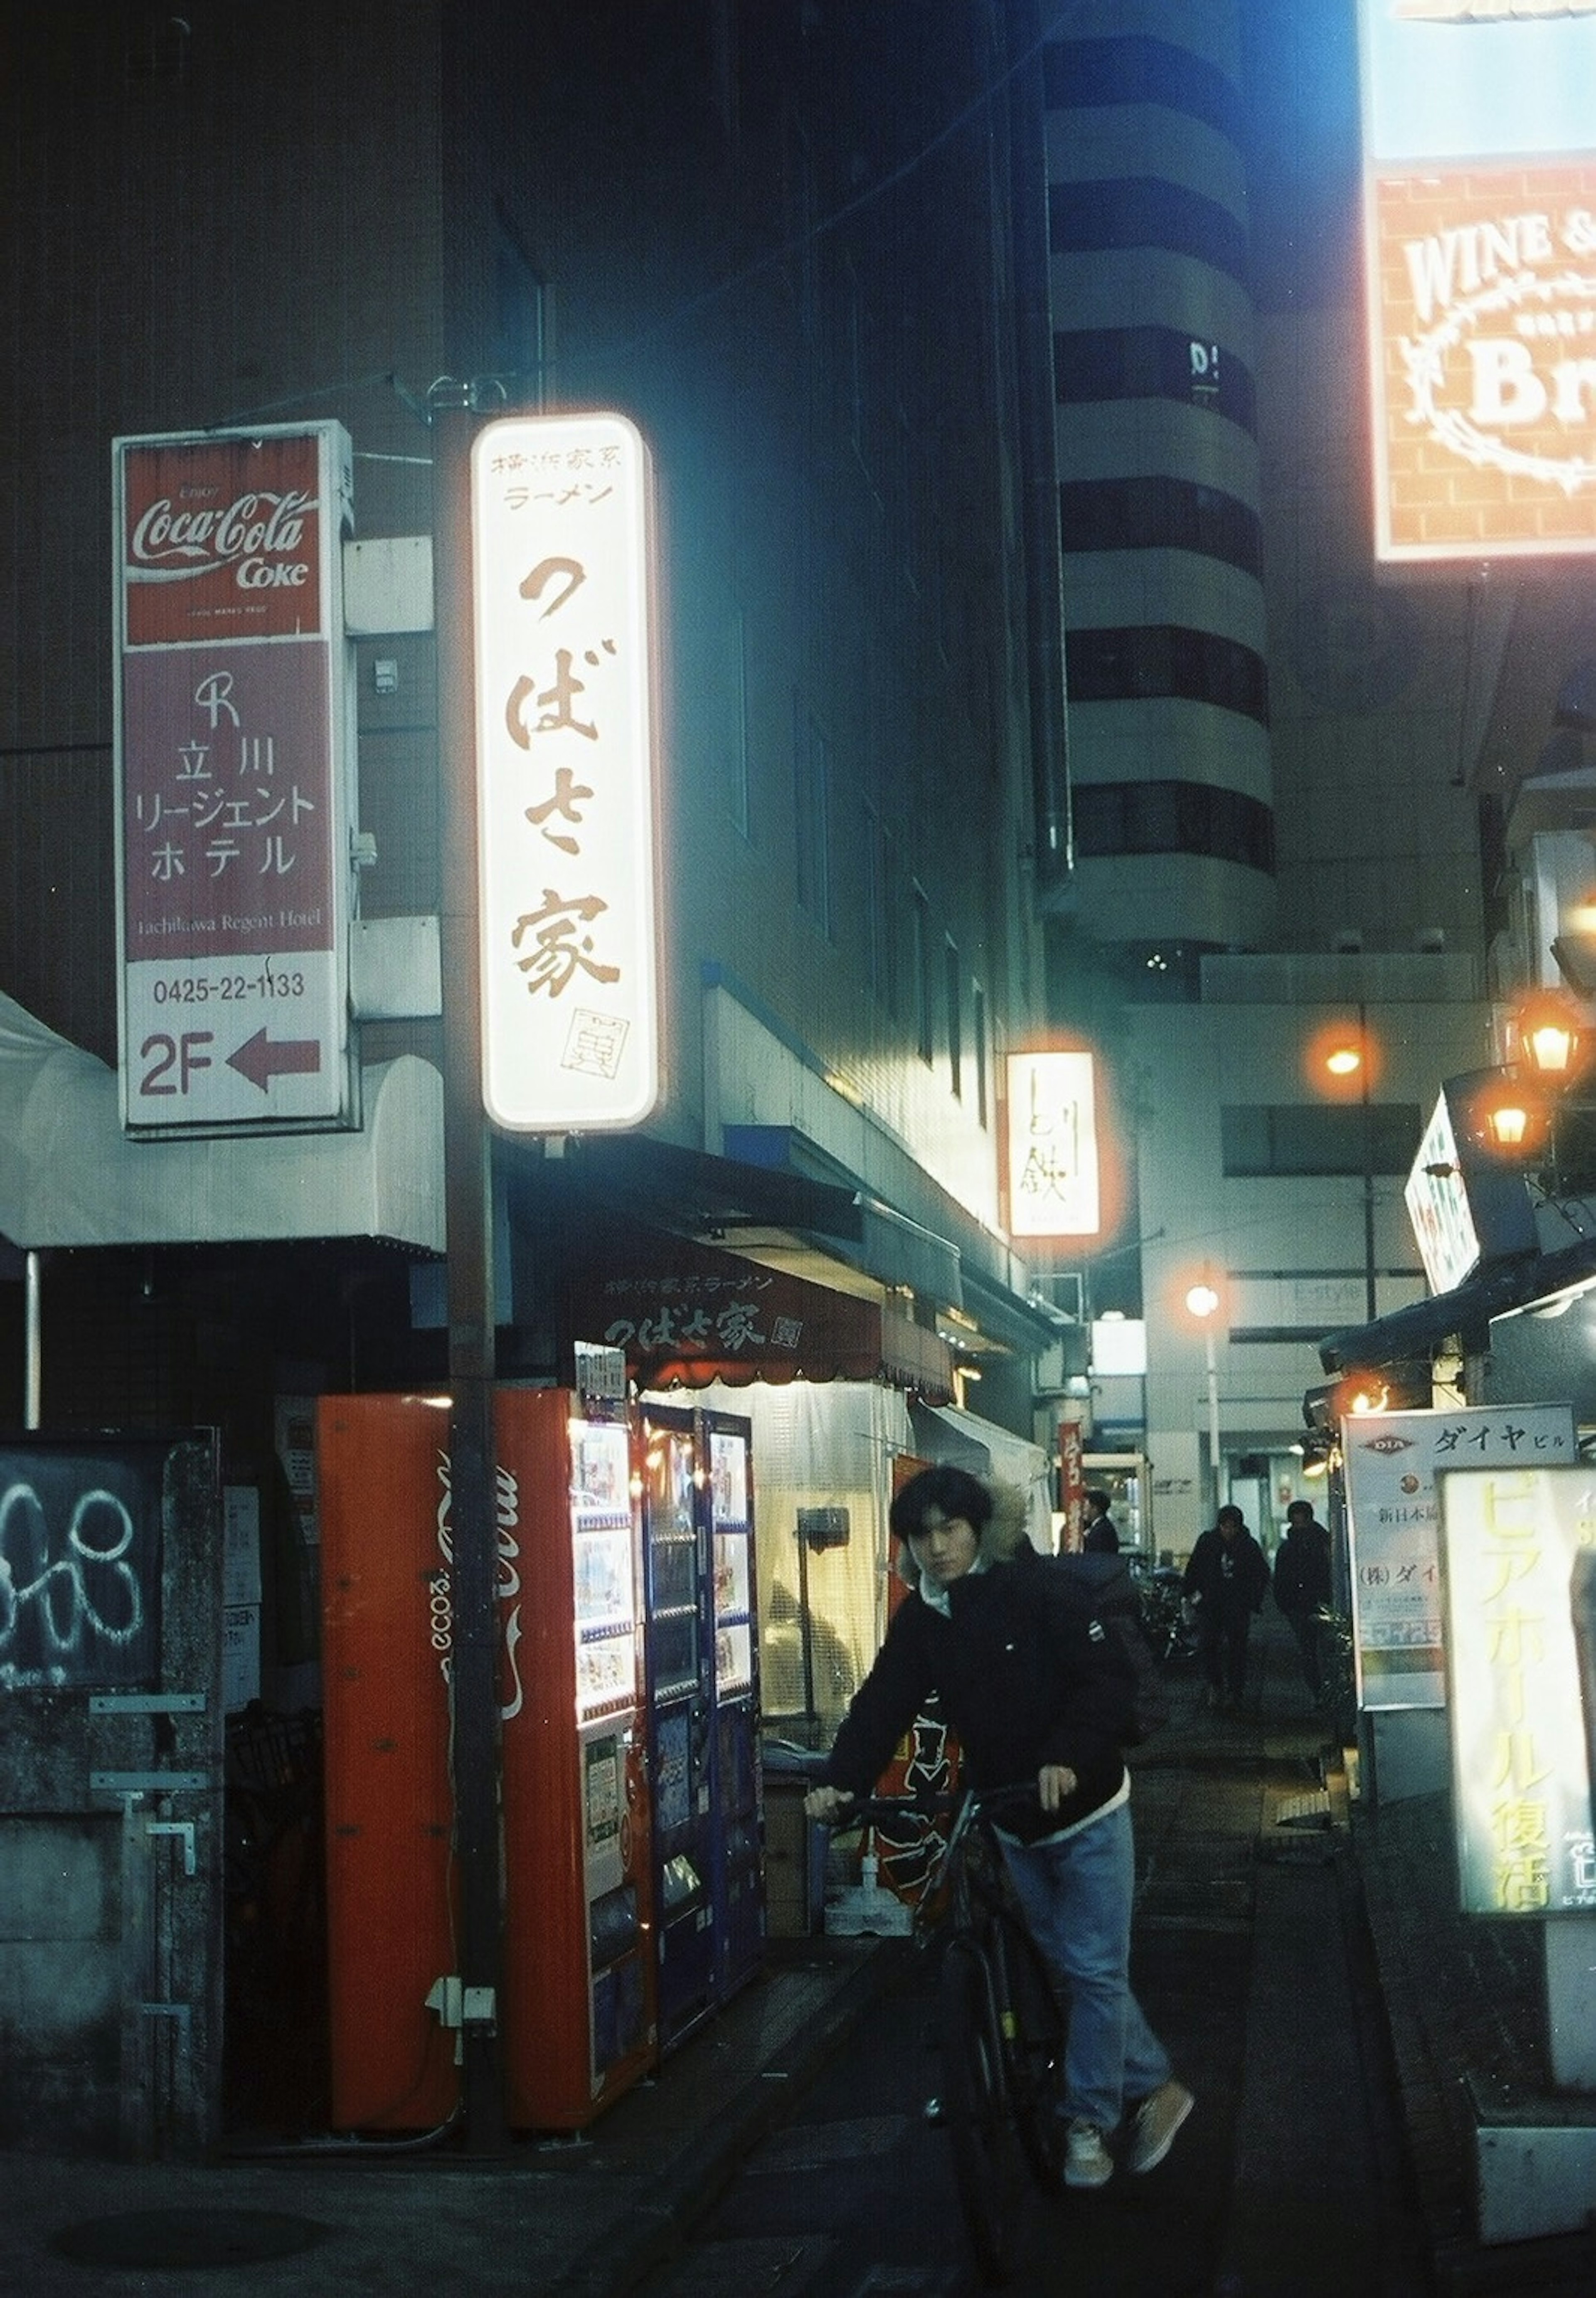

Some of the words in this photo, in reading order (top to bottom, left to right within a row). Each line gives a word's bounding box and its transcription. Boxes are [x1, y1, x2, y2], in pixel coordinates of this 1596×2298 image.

[1404, 213, 1553, 322] WINE
[1561, 209, 1596, 256] &
[504, 484, 613, 510] ラーメン
[133, 490, 309, 559] Coca-Cola
[236, 557, 309, 589] Coke
[176, 737, 273, 780] 立川
[505, 556, 621, 998] つばさ家
[137, 785, 315, 832] リージェント
[152, 836, 295, 880] ホテル
[222, 914, 273, 933] Regent
[279, 908, 321, 927] Hotel
[154, 973, 305, 1004] 0425-22-1133
[140, 1031, 214, 1096] 2F
[604, 1300, 766, 1351] つばさ家
[1482, 1471, 1554, 1911] ビアホール復活
